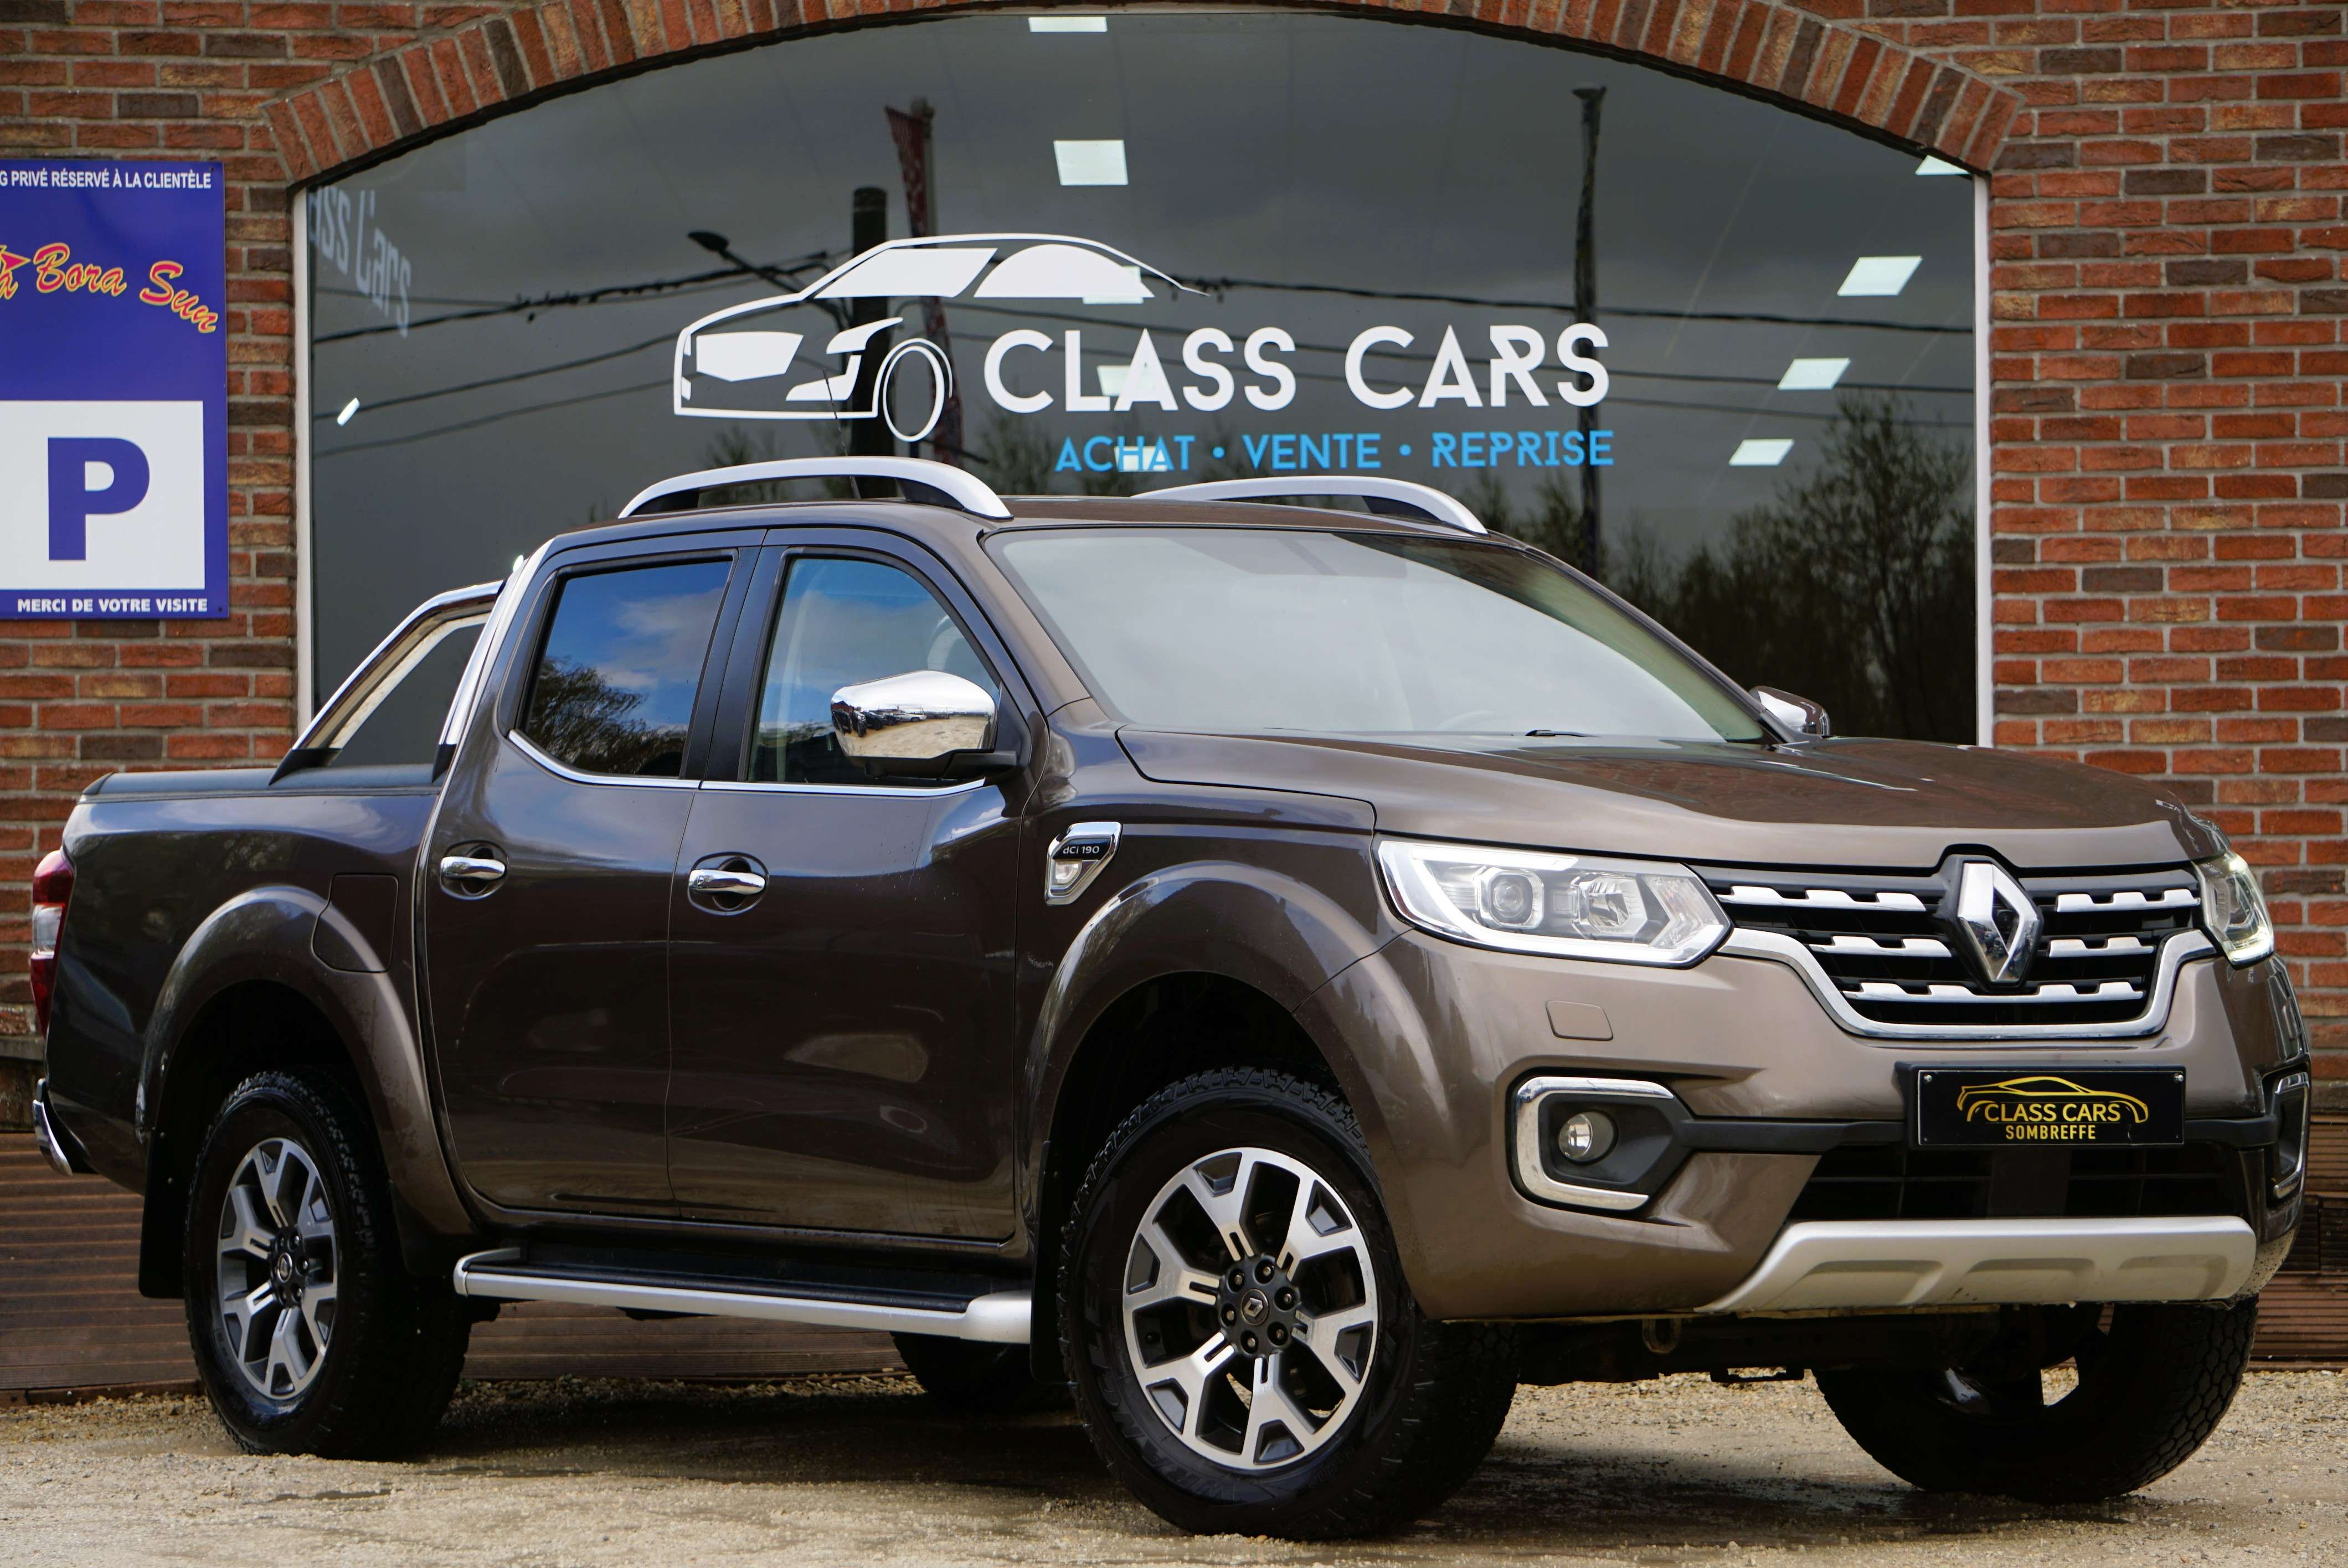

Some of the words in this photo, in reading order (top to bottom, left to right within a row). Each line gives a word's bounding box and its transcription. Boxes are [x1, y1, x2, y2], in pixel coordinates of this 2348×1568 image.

[11, 168, 48, 187] PRIVÉ
[51, 168, 110, 188] RÉSERVÉ
[112, 168, 122, 188] À
[125, 172, 142, 188] LA
[144, 169, 212, 189] CLIENTÈLE
[356, 189, 411, 338] Cars
[33, 243, 127, 296] Bora
[140, 260, 218, 333] Sun
[984, 327, 1295, 412] CLASS
[1345, 323, 1609, 409] CARS
[1055, 436, 1195, 472] ACHAT
[1243, 434, 1381, 470] VENTE
[1433, 430, 1614, 467] REPRISE
[48, 437, 150, 561] P
[17, 599, 66, 612] MERCI
[72, 599, 93, 612] DE
[98, 598, 151, 612] VOTRE
[156, 598, 208, 612] VISITE
[1063, 845, 1079, 854] dCi
[1081, 845, 1100, 854] 190
[1984, 1103, 2057, 1122] CLASS
[2062, 1103, 2120, 1122] CARS
[2006, 1125, 2096, 1139] SOMBREFFE
